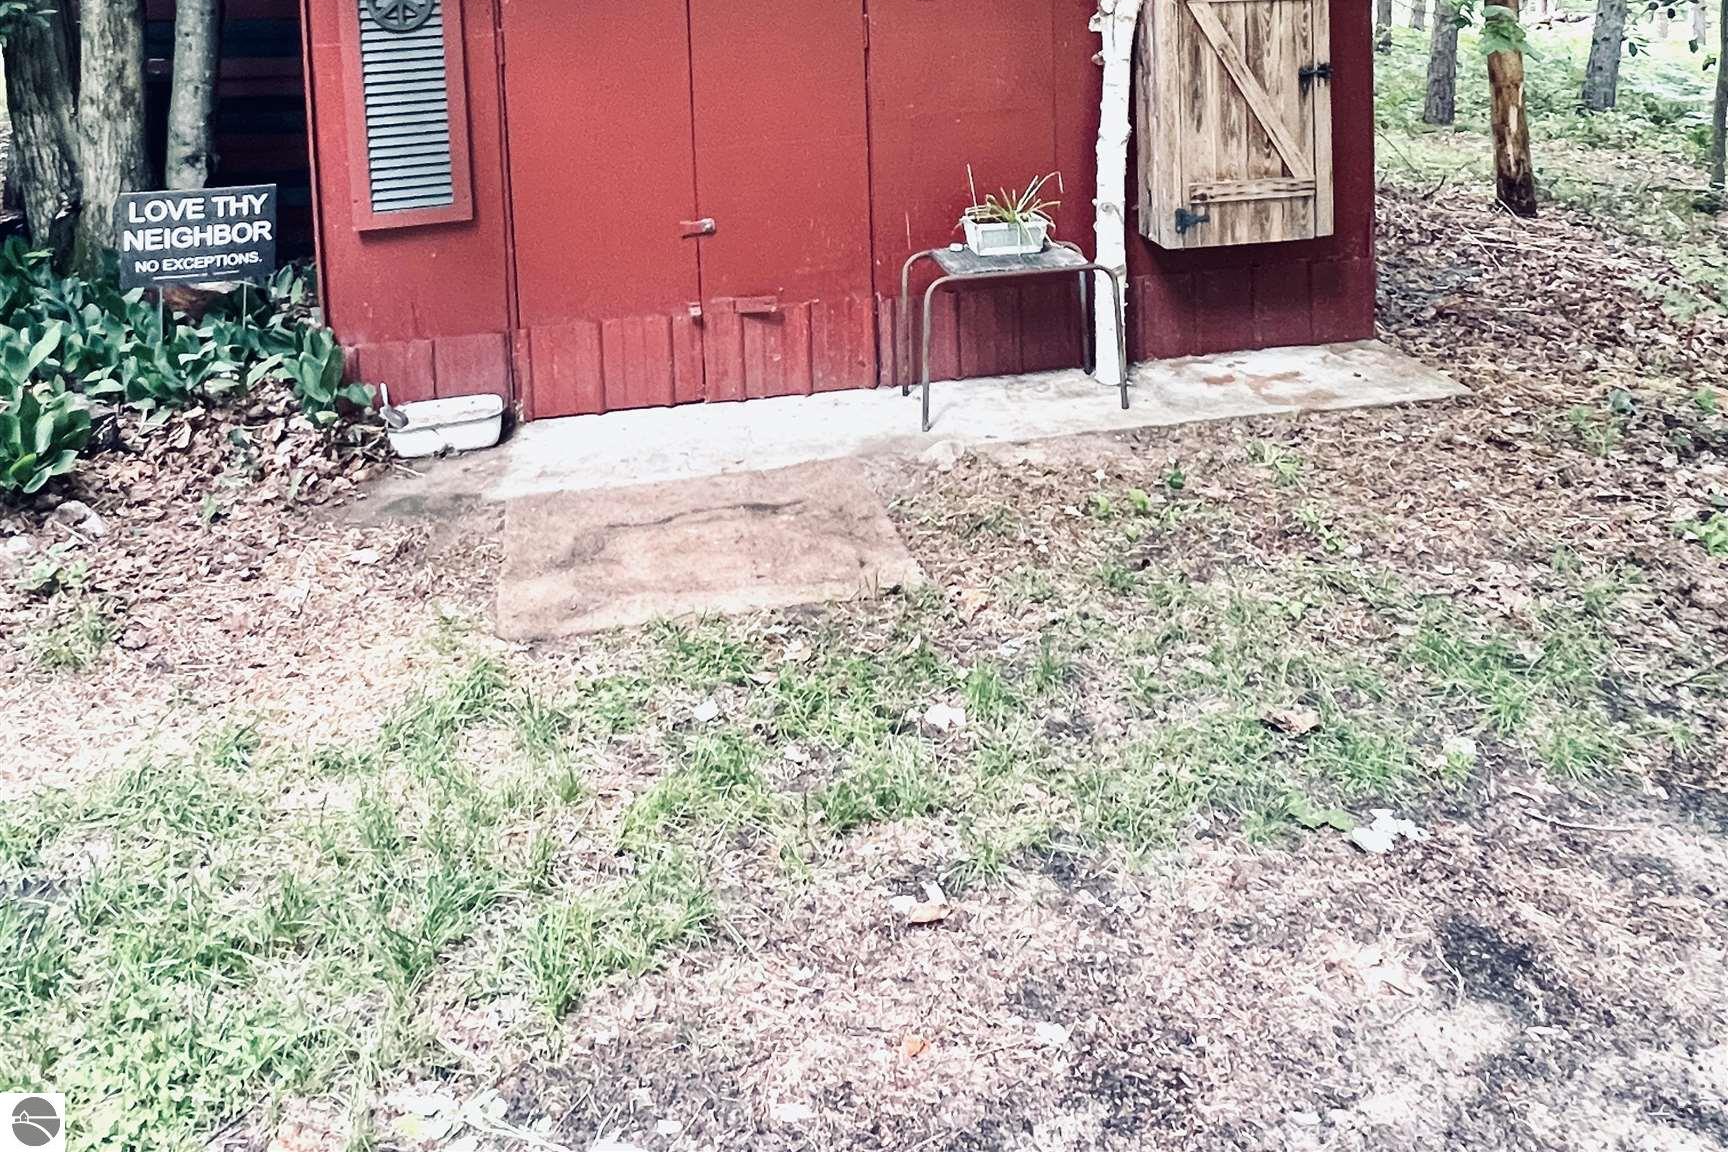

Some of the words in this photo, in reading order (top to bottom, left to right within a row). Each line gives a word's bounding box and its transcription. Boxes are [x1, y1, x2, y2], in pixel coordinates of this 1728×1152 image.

[128, 198, 205, 223] LOVE
[211, 193, 268, 218] THY
[123, 220, 273, 252] NEIGHBOR
[135, 260, 160, 273] NO
[162, 251, 263, 272] EXCEPTIONS.
